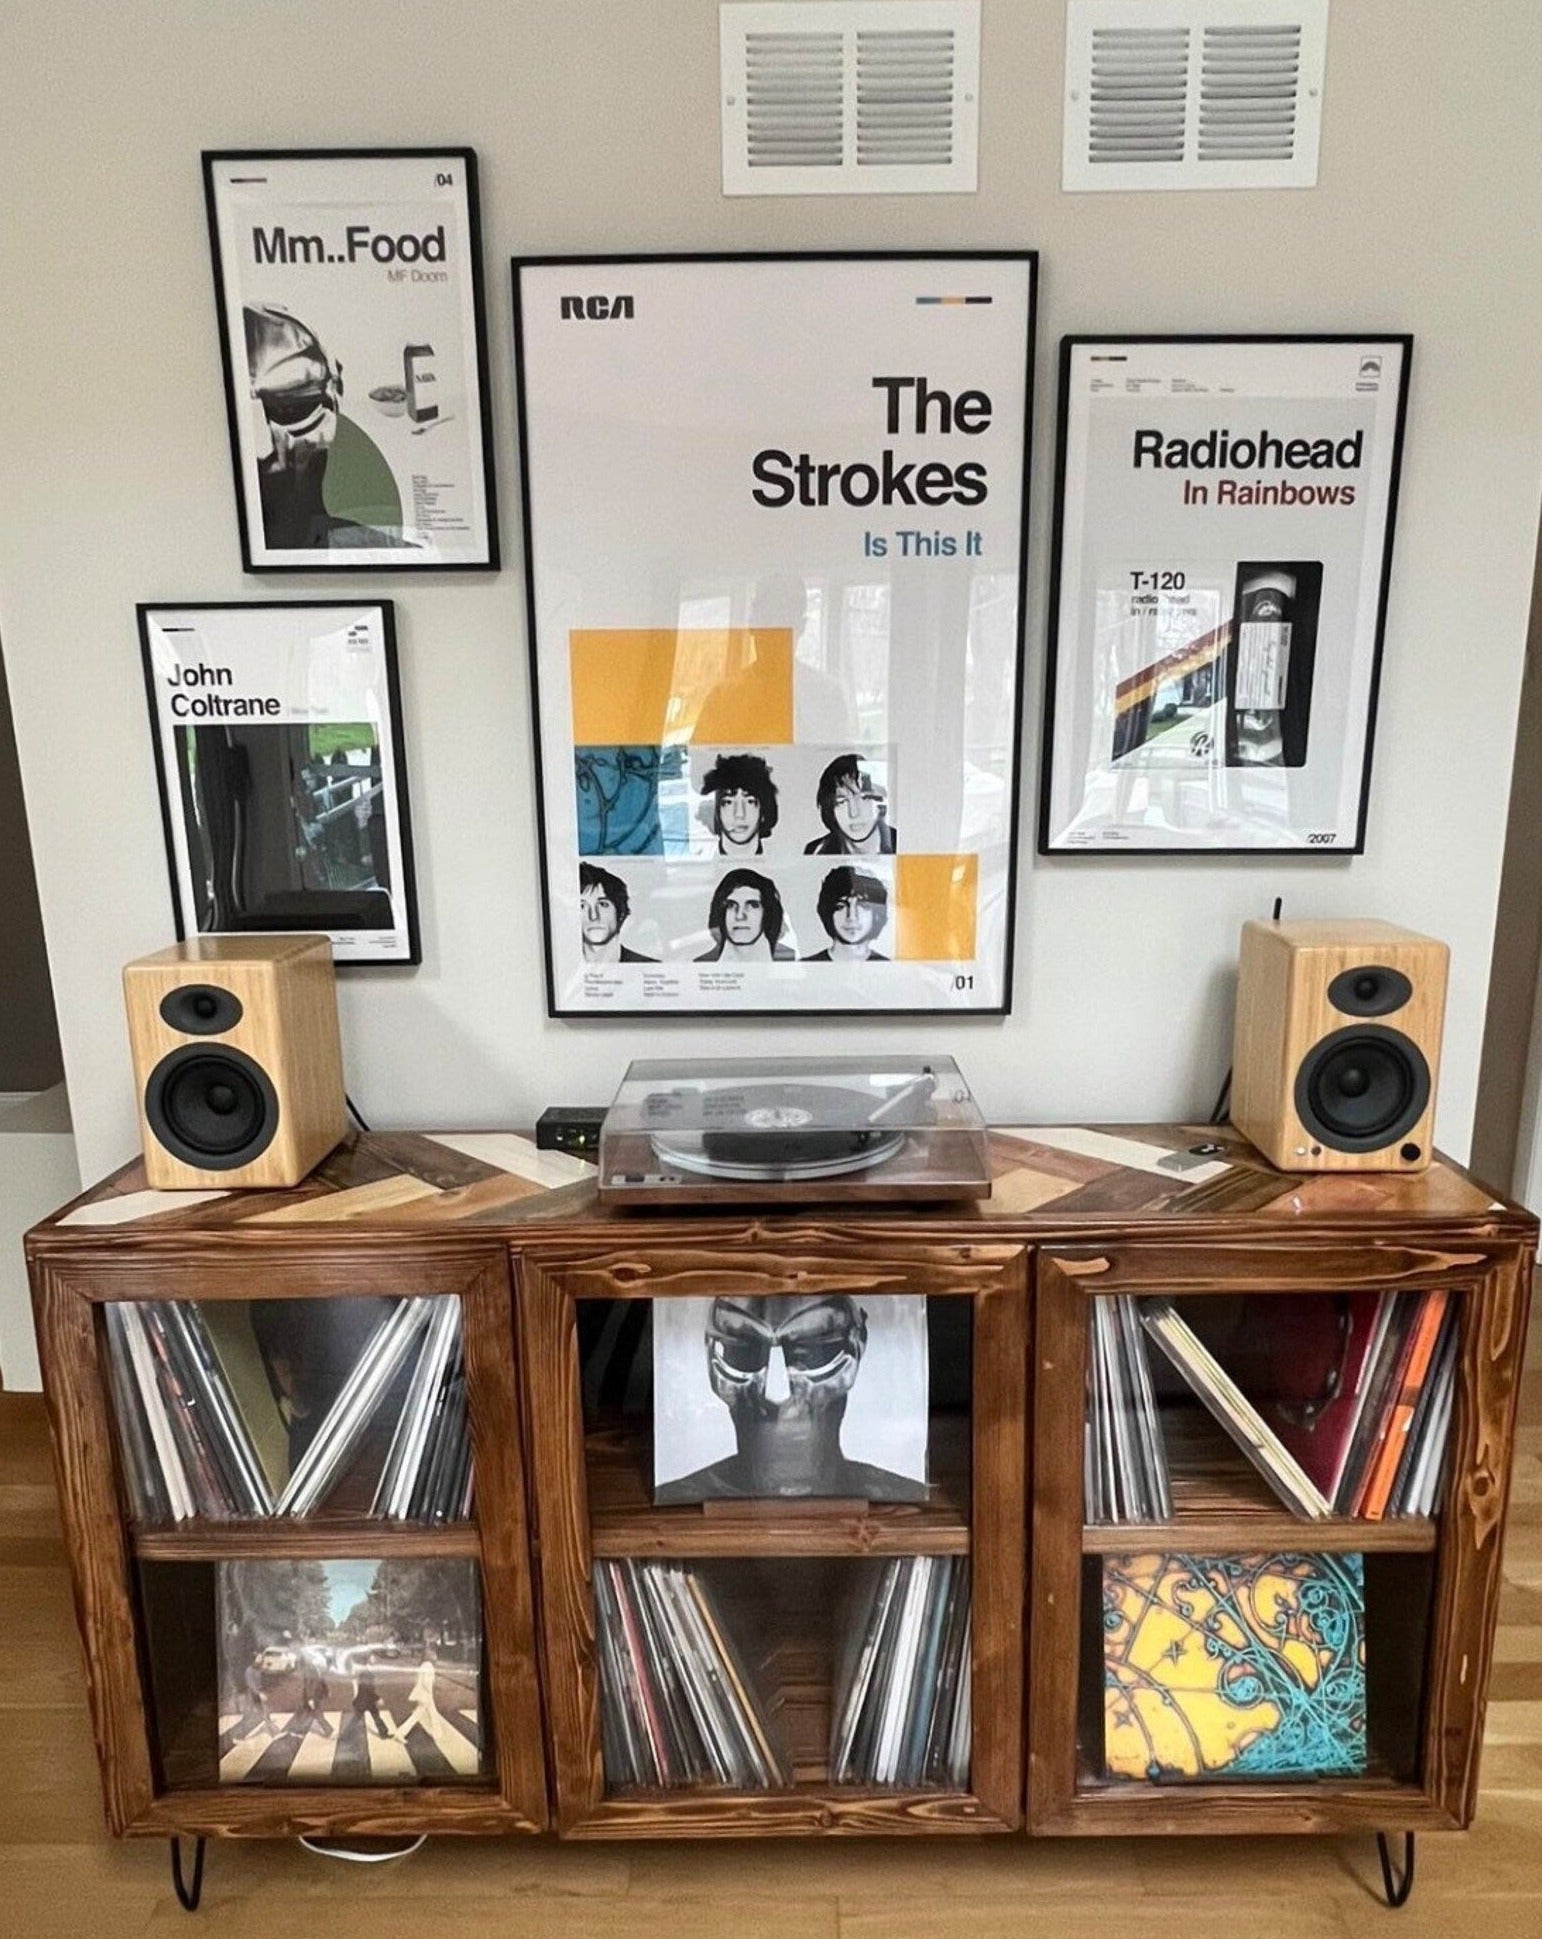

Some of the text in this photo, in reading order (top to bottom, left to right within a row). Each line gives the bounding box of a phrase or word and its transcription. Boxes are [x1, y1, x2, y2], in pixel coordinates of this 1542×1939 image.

[252, 225, 446, 264] Mm..Food
[411, 268, 449, 283] Doom
[560, 295, 635, 320] RCA
[872, 376, 993, 435] The
[1133, 429, 1364, 469] Radiohead
[752, 448, 989, 508] Strokes
[1183, 479, 1356, 506] In Rainbows
[863, 530, 983, 557] Is This It
[1130, 571, 1186, 590] T-120
[168, 663, 233, 687] John
[171, 693, 281, 717] Coltrane
